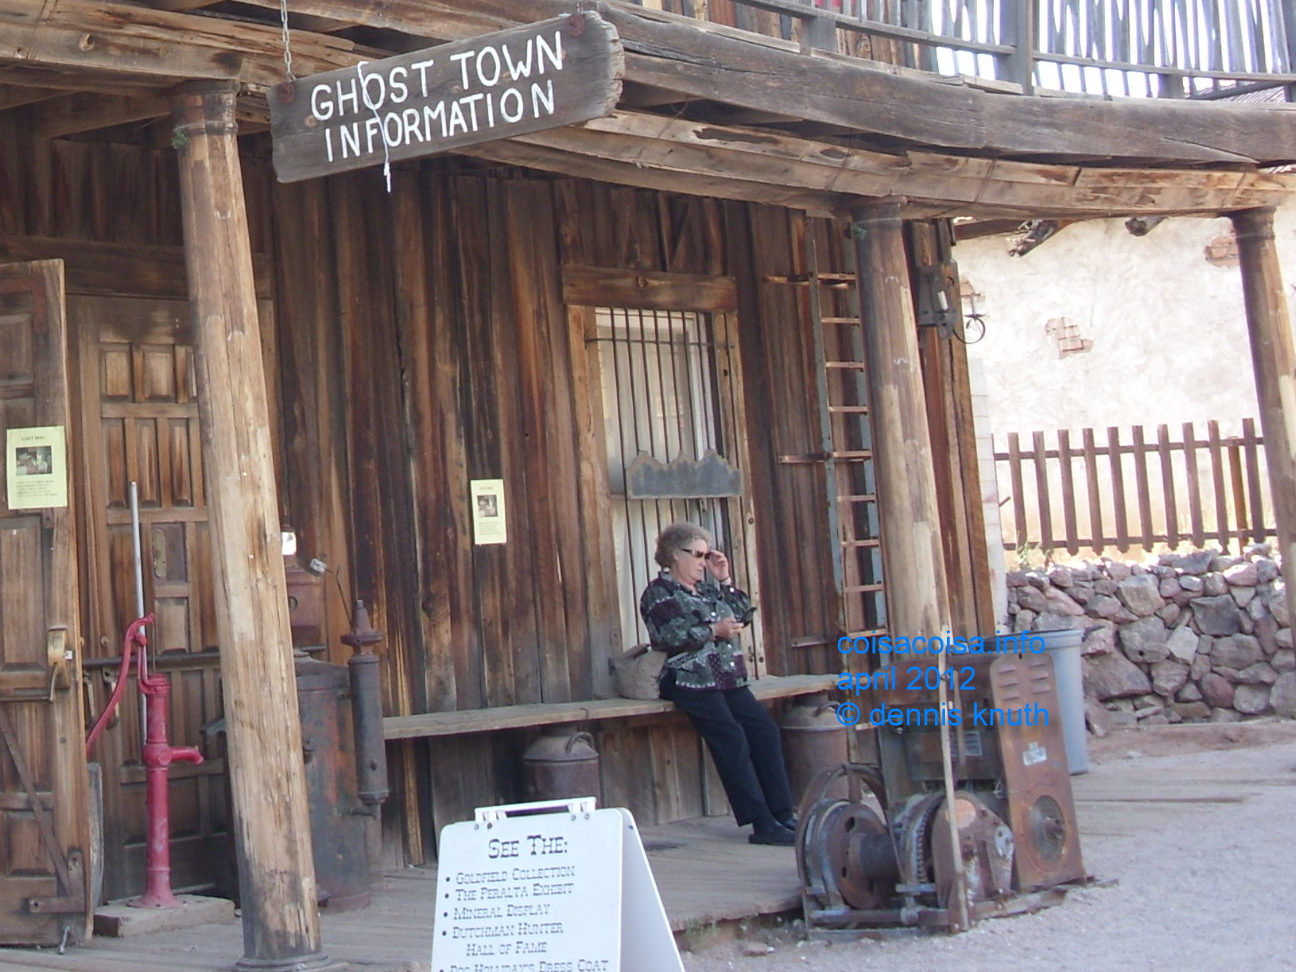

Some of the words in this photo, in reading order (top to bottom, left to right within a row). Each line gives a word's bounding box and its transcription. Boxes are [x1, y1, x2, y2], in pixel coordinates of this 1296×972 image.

[311, 58, 435, 121] GHOST
[450, 31, 563, 90] TOWN
[325, 79, 555, 162] INFORMATION
[488, 838, 520, 859] SEE
[527, 834, 568, 856] THE:
[456, 872, 508, 885] GOLDFIELD
[512, 866, 575, 881] COLLECTION
[456, 888, 477, 902] THE
[480, 886, 529, 900] PERALTA
[532, 882, 575, 897] EXHIBIT
[453, 907, 503, 921] MINERAL
[507, 903, 551, 917] DISPLAY
[452, 925, 515, 939] DUTCHMAN
[518, 922, 564, 936] HUNTER
[466, 943, 495, 957] HALL
[499, 943, 512, 955] OF
[516, 941, 548, 955] FAME
[577, 958, 609, 972] COAT
